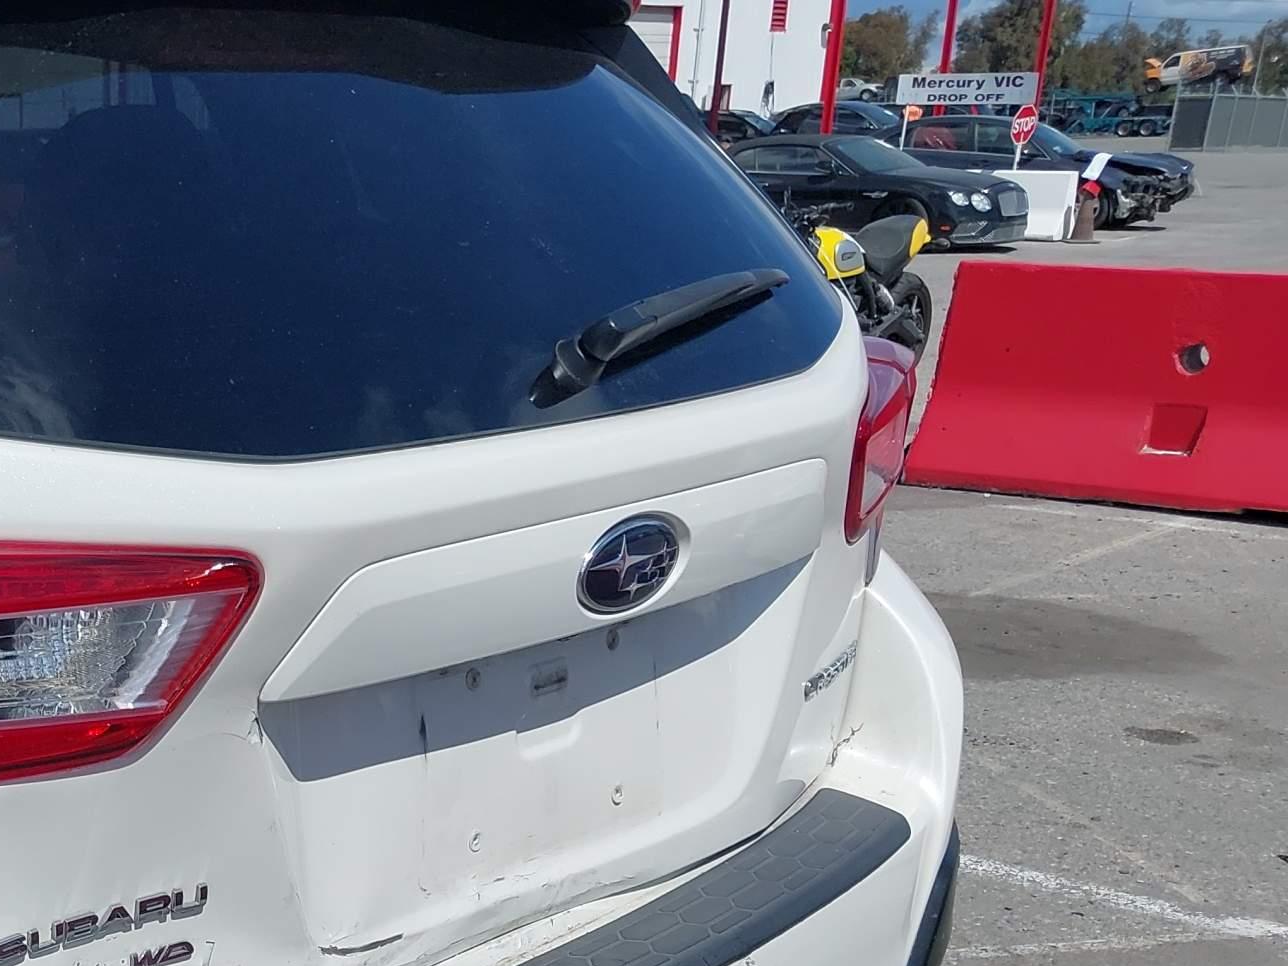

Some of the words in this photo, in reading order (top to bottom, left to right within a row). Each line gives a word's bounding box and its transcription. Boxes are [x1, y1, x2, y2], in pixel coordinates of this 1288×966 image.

[912, 76, 985, 90] Mercury
[994, 75, 1024, 88] VIC
[927, 93, 968, 102] DROP
[974, 93, 1005, 102] OFF
[1013, 117, 1036, 134] STOP
